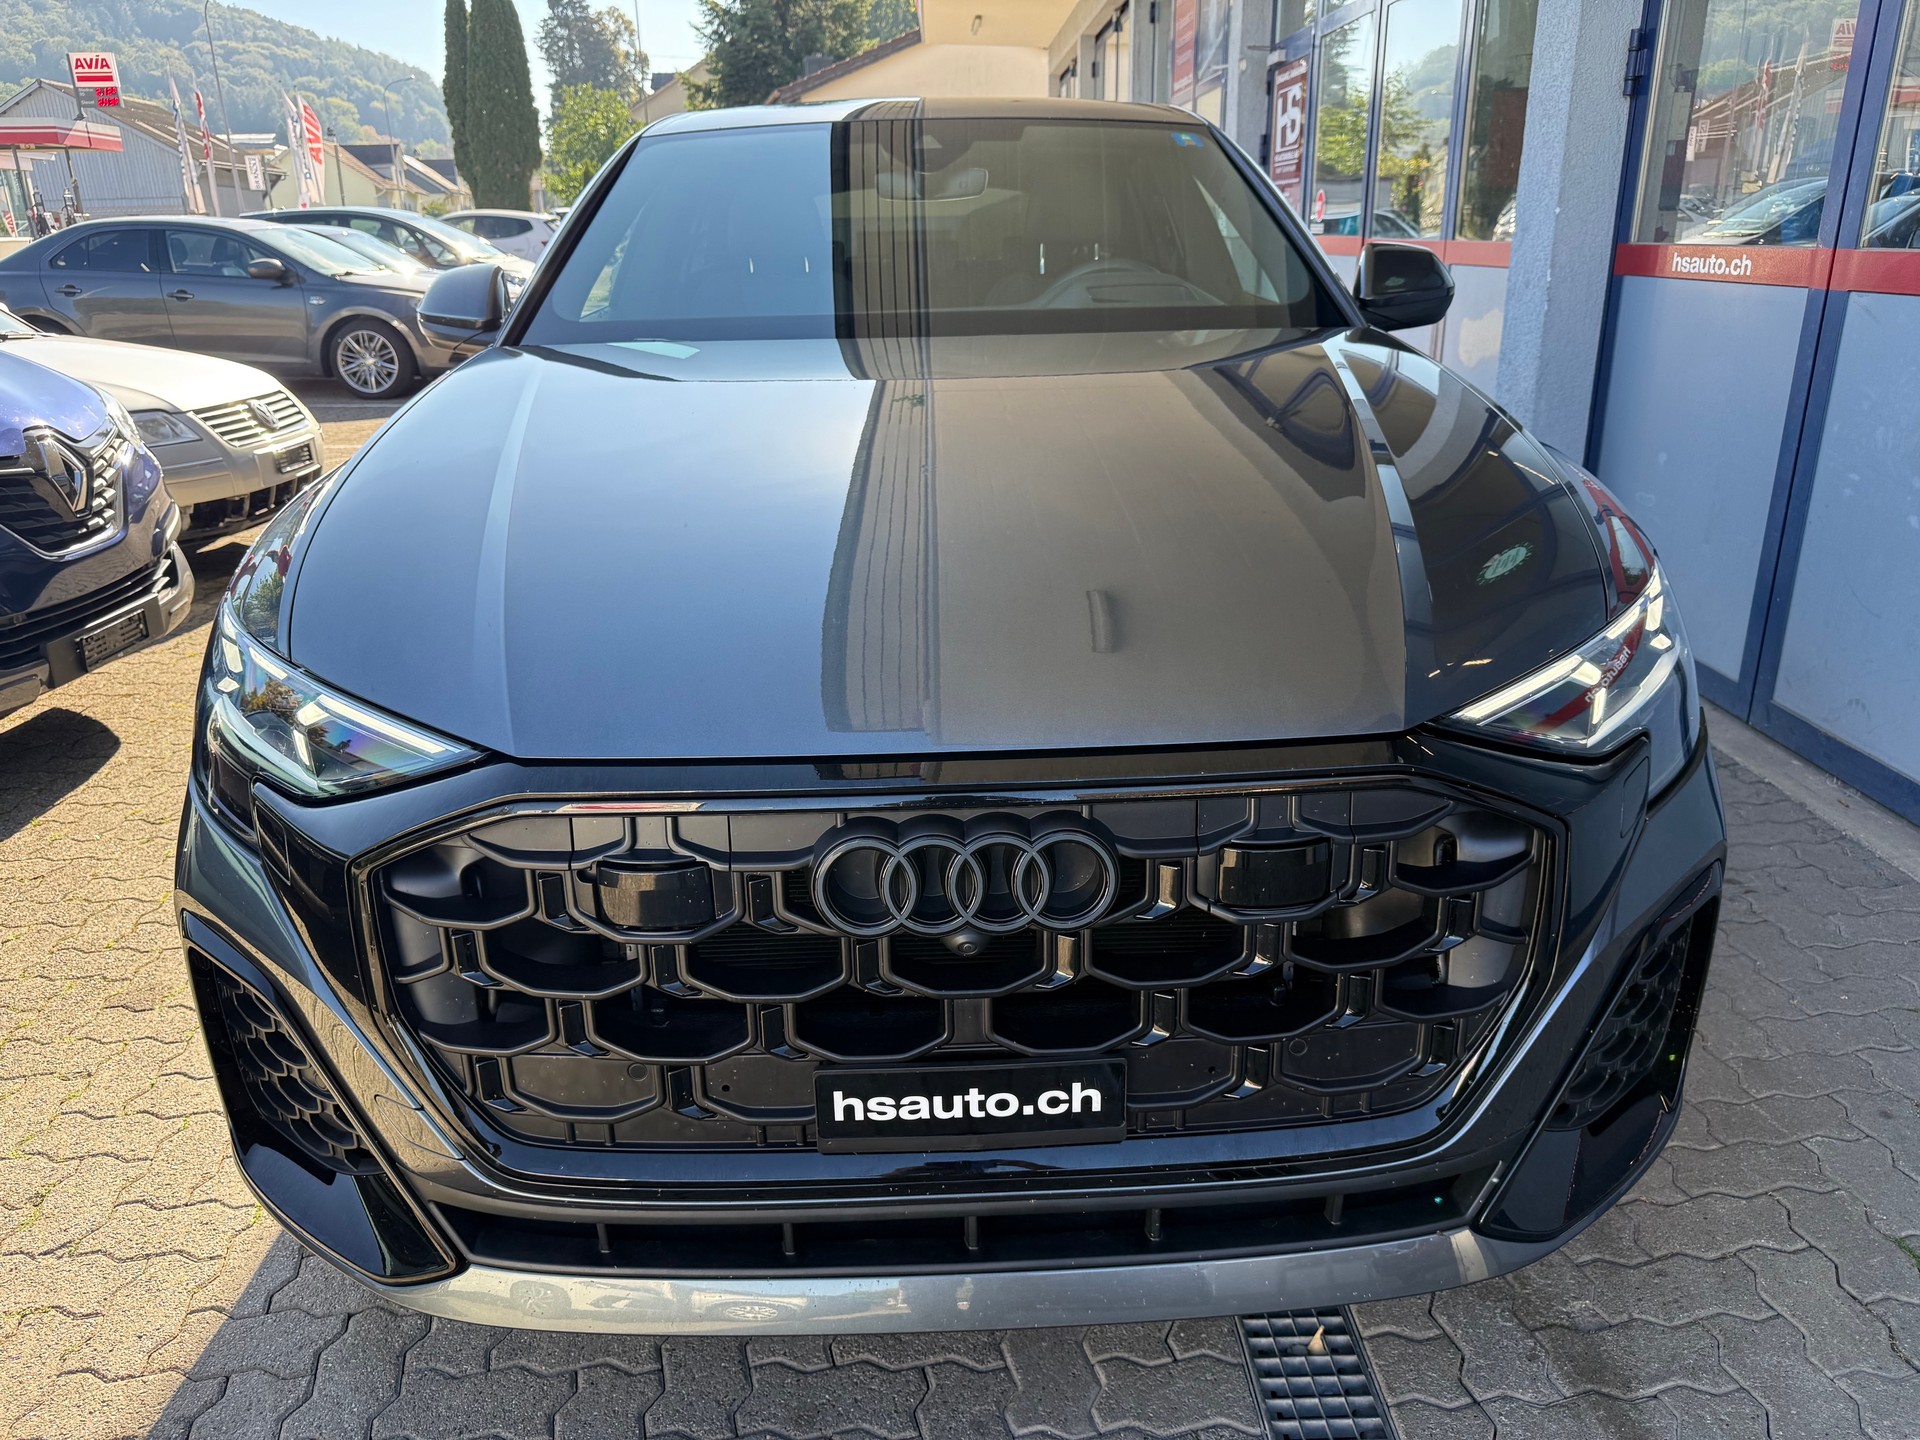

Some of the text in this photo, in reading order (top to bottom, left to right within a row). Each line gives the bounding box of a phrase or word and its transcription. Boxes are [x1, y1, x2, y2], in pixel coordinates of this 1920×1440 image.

[74, 54, 111, 70] AVIA
[1672, 252, 1752, 275] hsauto.ch
[832, 1082, 1102, 1122] hsauto.ch
